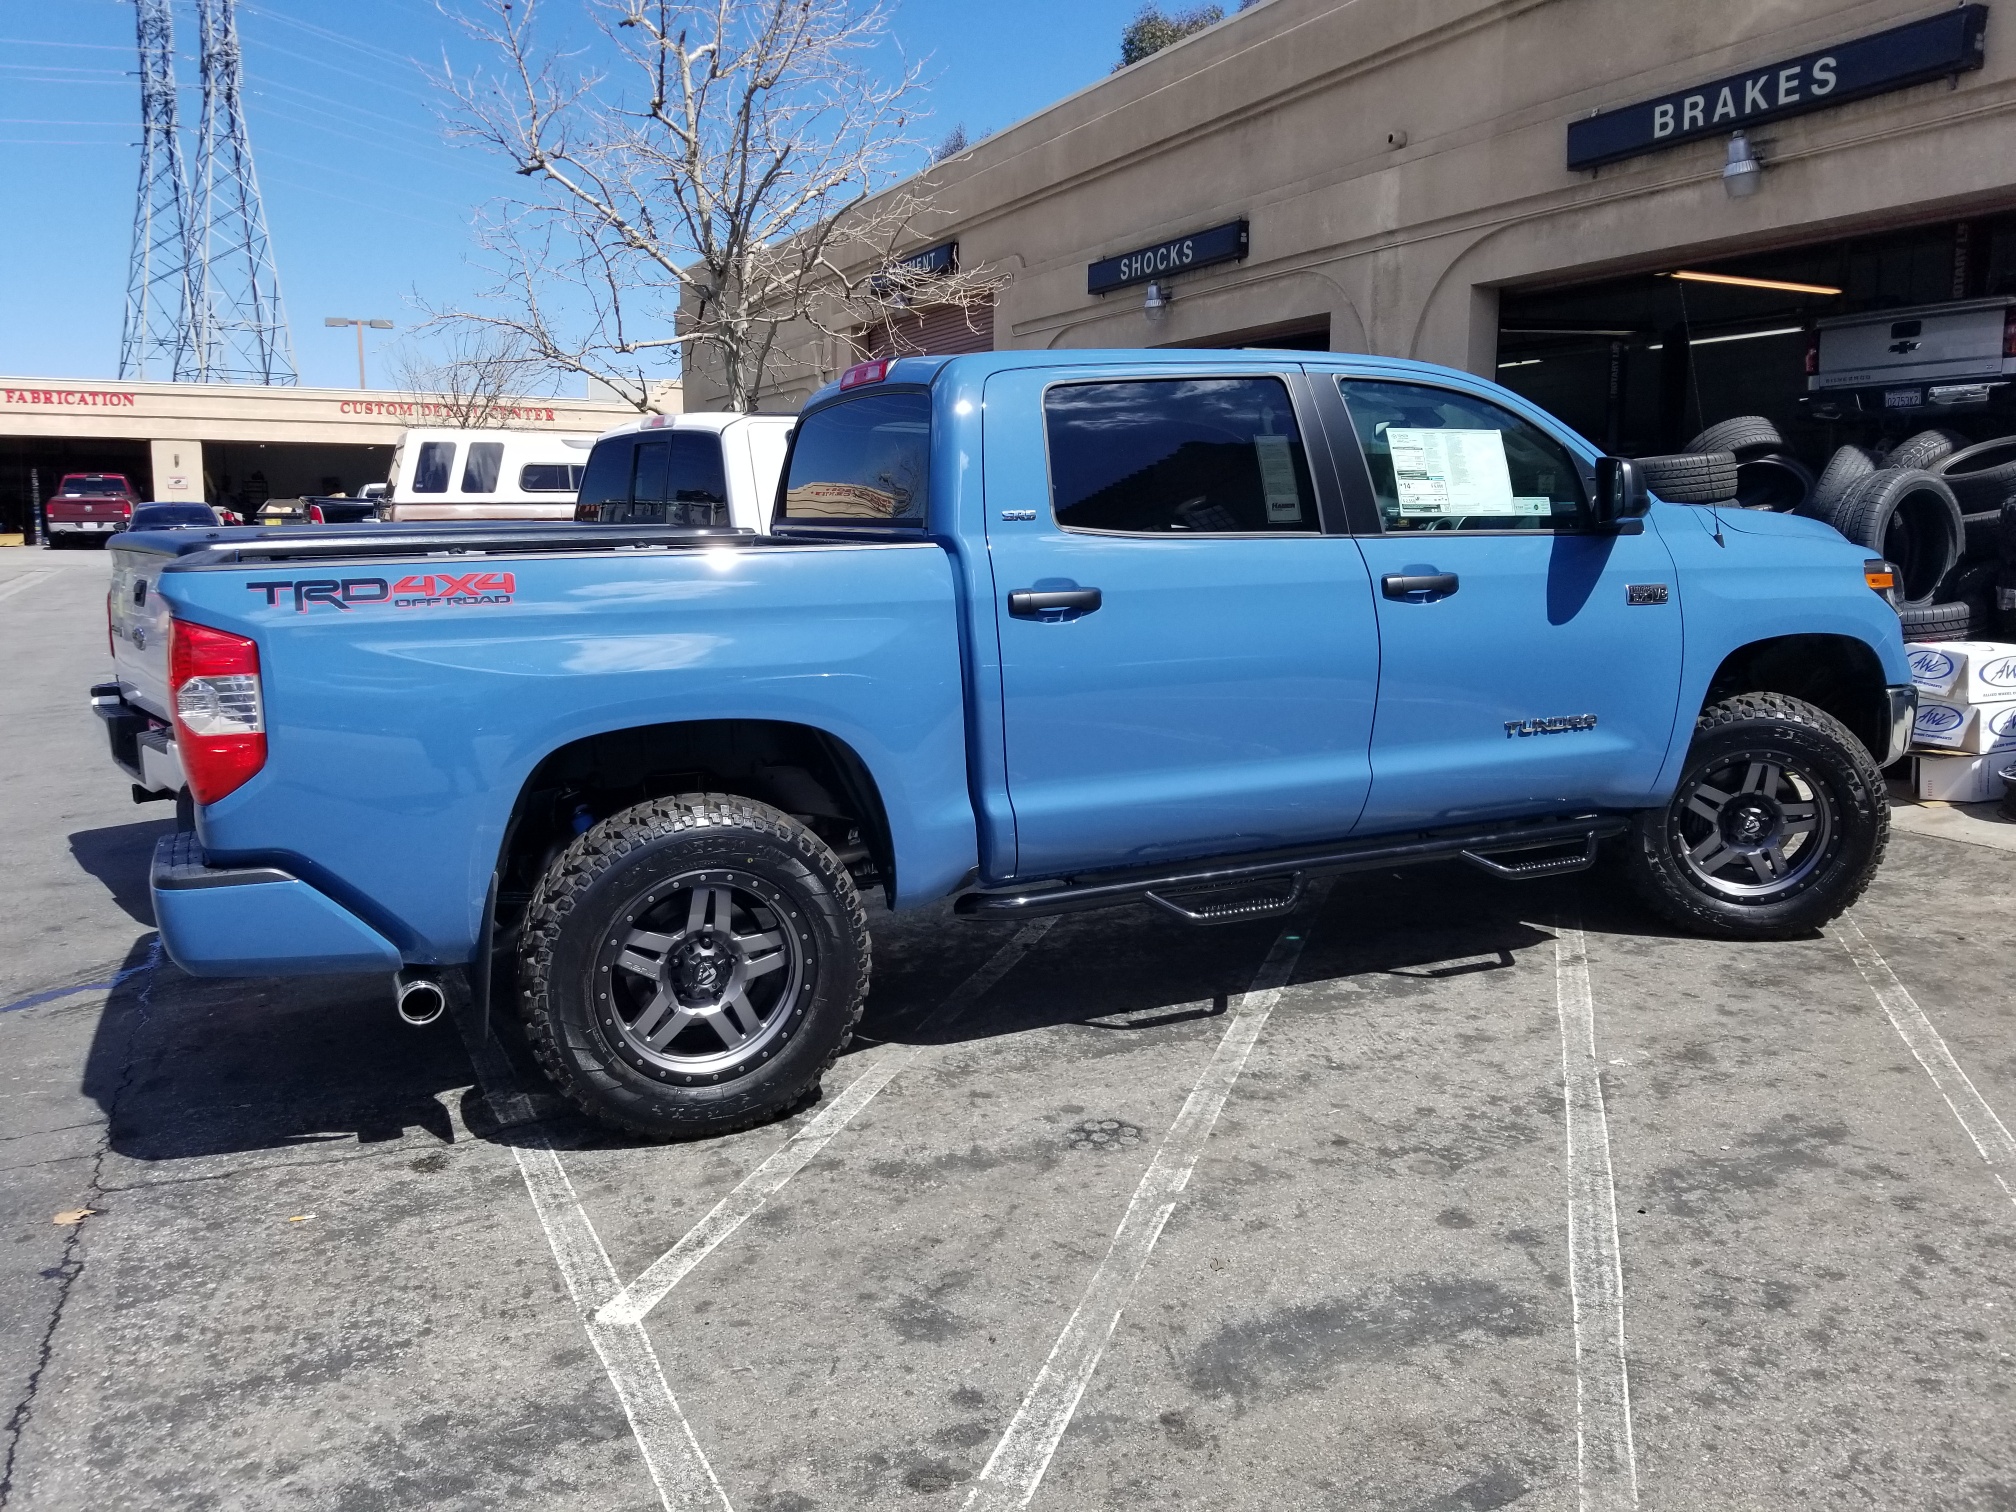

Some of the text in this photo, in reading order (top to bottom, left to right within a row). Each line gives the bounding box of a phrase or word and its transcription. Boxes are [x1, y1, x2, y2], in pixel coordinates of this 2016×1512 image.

[1653, 56, 1838, 139] BRAKES
[1120, 240, 1193, 280] SHOCKS
[5, 389, 135, 407] FABRICATION
[340, 401, 414, 416] CUSTOM
[1002, 509, 1036, 521] SR5
[246, 577, 392, 614] TRD
[394, 594, 512, 609] OFF ROAD
[1911, 653, 1947, 672] AWC
[1504, 713, 1598, 736] TUNDRA
[1915, 707, 1955, 726] AWC
